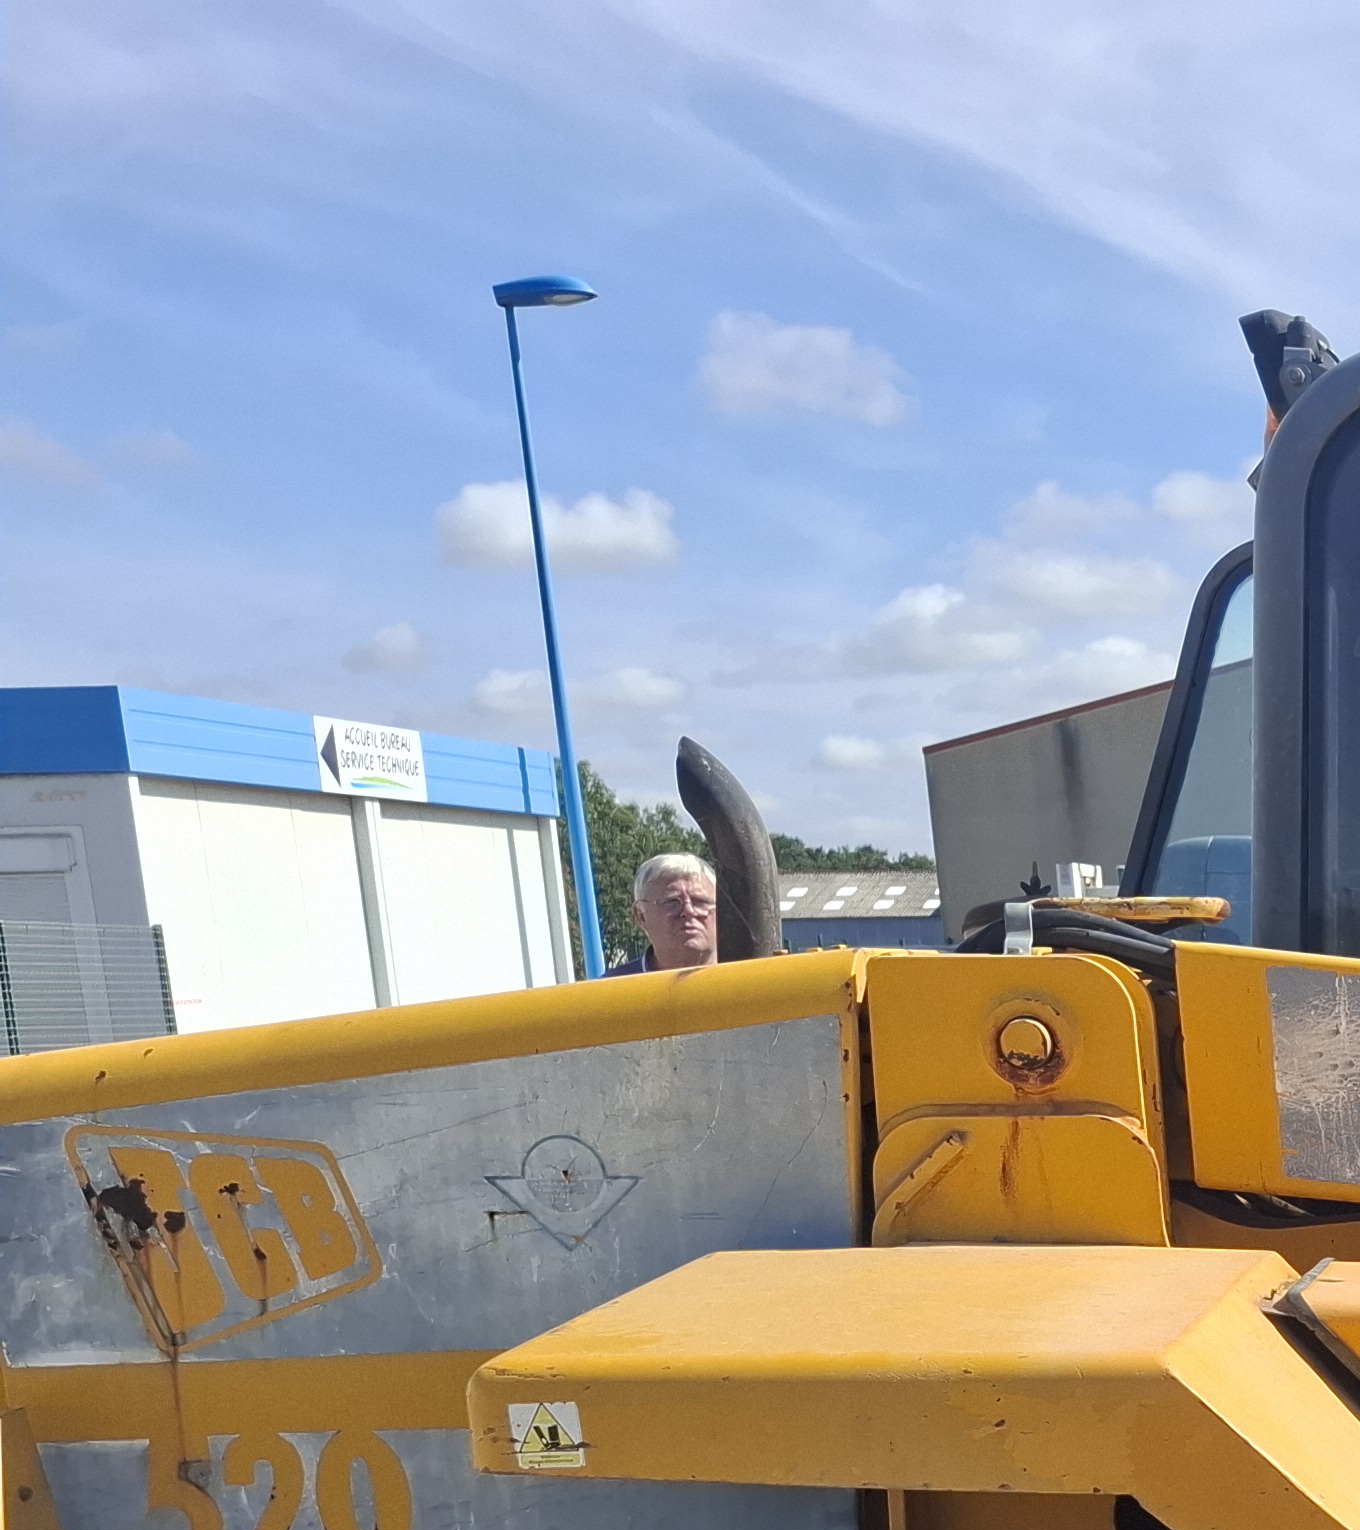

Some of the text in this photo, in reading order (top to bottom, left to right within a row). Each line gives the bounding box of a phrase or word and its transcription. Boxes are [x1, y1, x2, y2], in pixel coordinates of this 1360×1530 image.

[344, 727, 411, 752] ACCUEIL BUREAU
[340, 749, 420, 777] SERVICE TECHNIQUE
[98, 1146, 358, 1333] JCB
